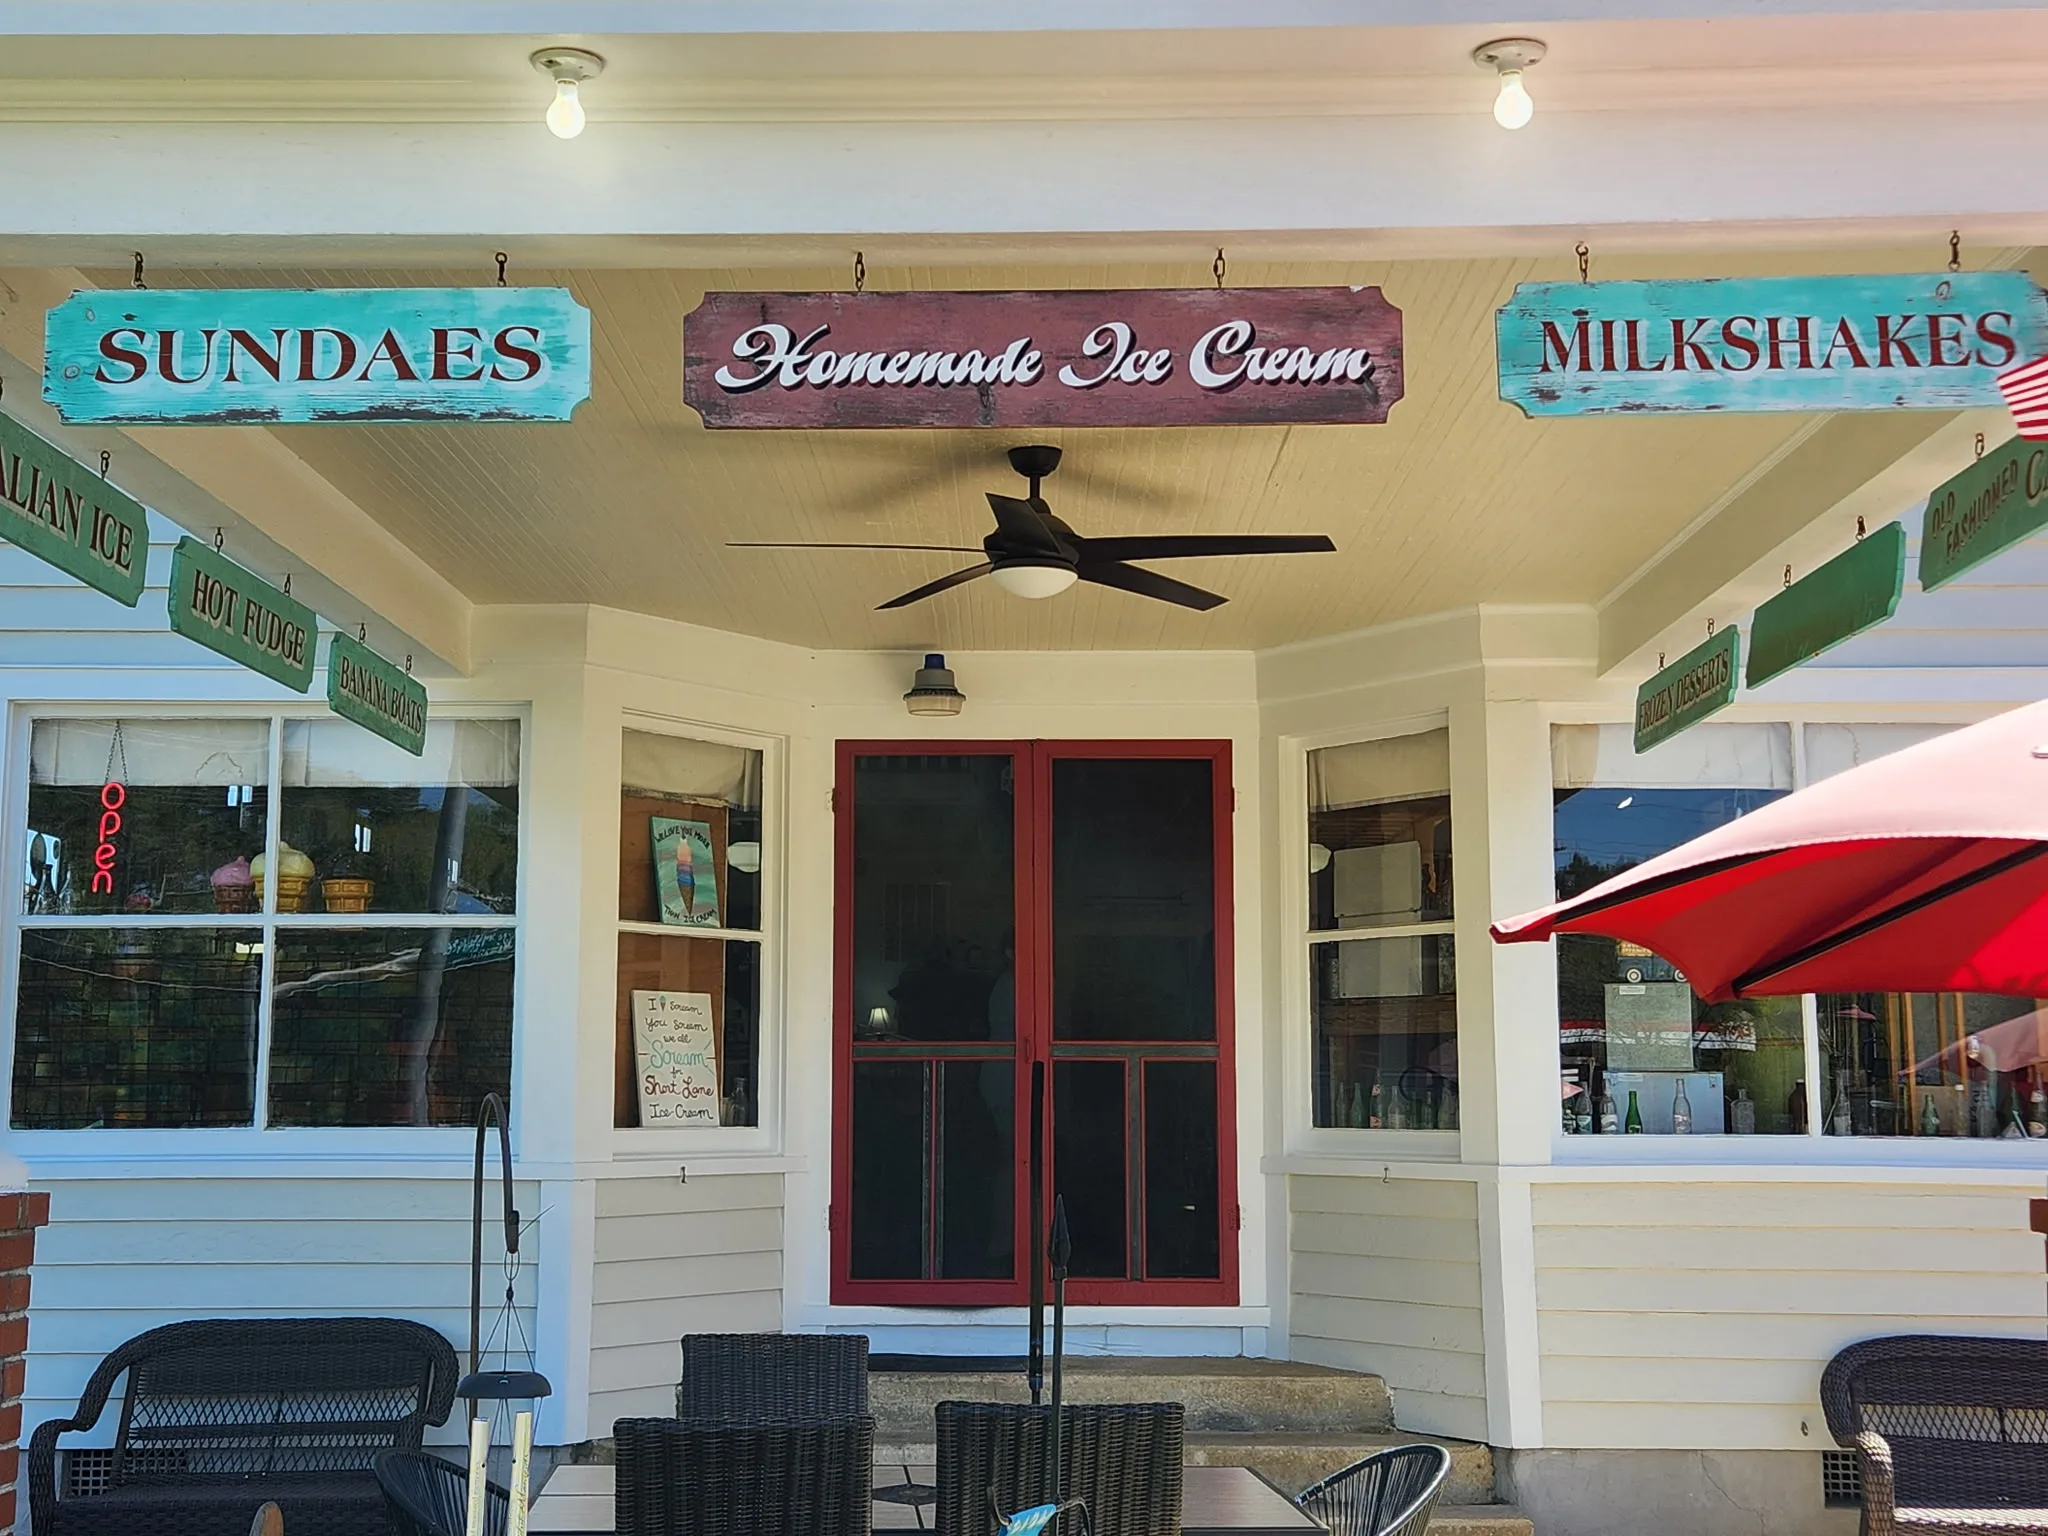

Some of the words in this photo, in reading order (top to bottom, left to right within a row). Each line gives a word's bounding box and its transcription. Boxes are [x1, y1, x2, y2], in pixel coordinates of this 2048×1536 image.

[95, 326, 543, 385] SUNDAES
[715, 322, 1043, 389] Homemade
[1059, 322, 1172, 387] Ice
[1190, 320, 1374, 388] Cream
[1539, 312, 2017, 374] MILKSHAKES
[89, 504, 133, 572] ICE
[1932, 491, 1955, 539] OLD
[1946, 459, 2019, 563] FASHIONED
[191, 568, 239, 630] HOT
[242, 597, 306, 666] FUDGE
[340, 656, 388, 714] BANANA
[391, 687, 423, 735] BOATS
[1637, 683, 1675, 733] FROZEN
[1675, 648, 1729, 711] DESSERTS
[648, 998, 657, 1011] I
[650, 1040, 709, 1069] Scream
[663, 1034, 676, 1043] we
[645, 1075, 681, 1096] Short
[681, 1076, 714, 1099] Lane
[670, 1066, 683, 1078] for
[674, 1103, 713, 1120] Cream
